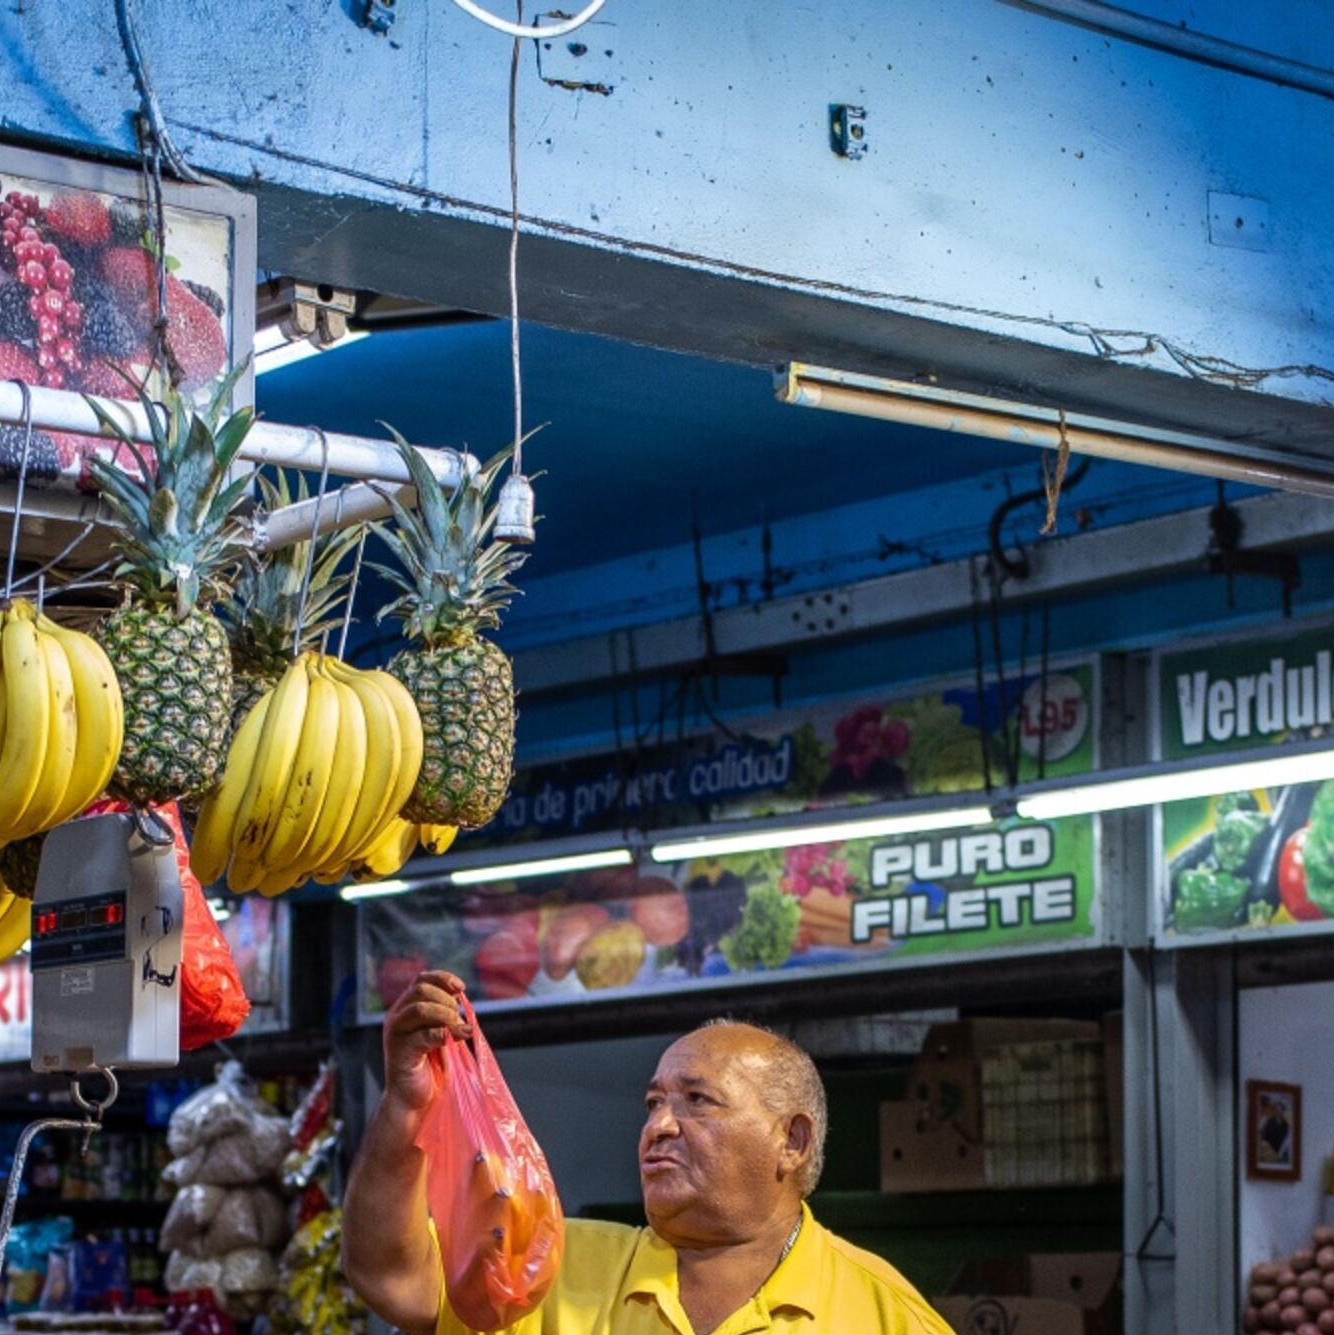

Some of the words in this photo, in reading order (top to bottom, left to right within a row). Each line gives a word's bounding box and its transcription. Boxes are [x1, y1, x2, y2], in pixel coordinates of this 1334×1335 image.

[533, 781, 567, 823] de
[689, 739, 793, 798] calidad
[870, 824, 1056, 888] PURO
[851, 875, 1076, 943] FILETE
